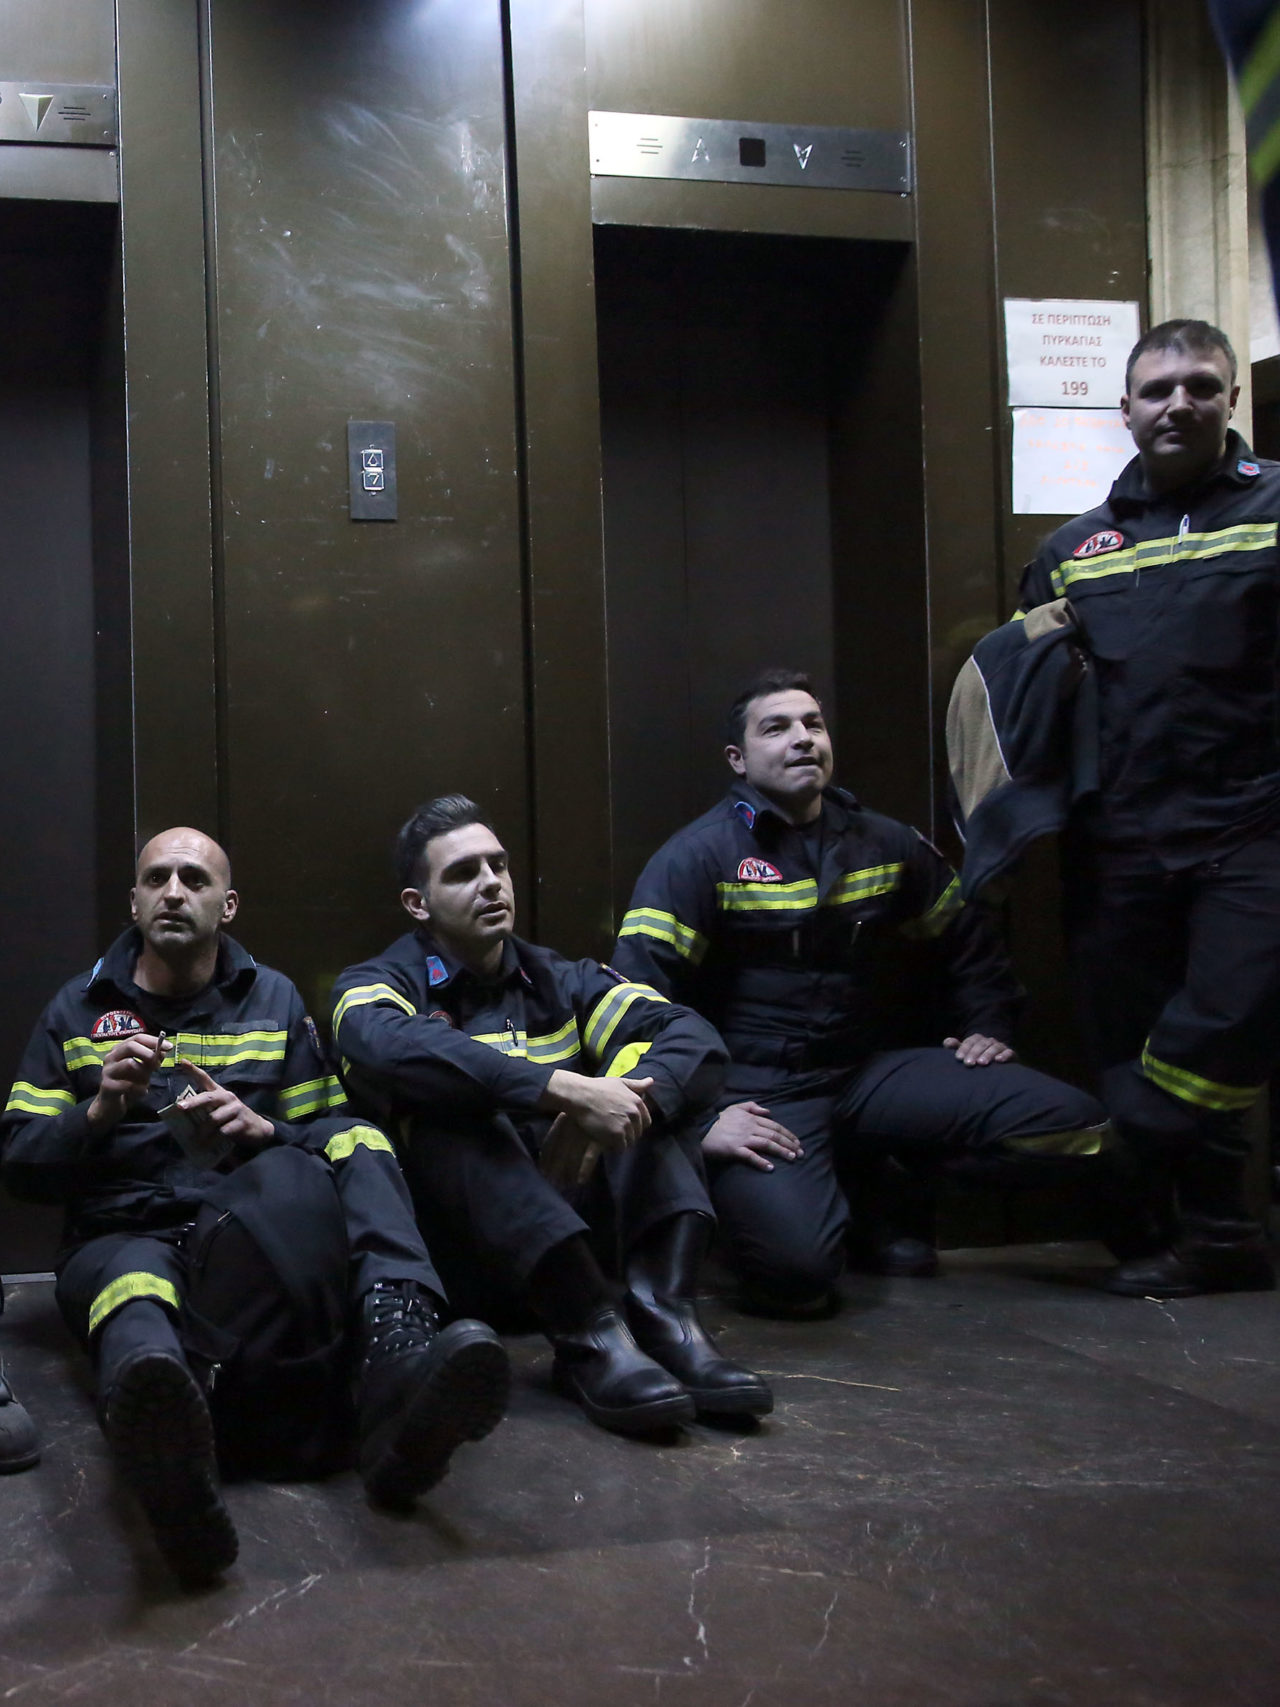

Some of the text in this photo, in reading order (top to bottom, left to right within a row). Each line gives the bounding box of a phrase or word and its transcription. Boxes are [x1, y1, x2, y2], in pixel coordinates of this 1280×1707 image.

[1032, 313, 1112, 327] ΣΕ ΠΕΡΙΠΤΩΣΗ
[1040, 355, 1107, 368] ΚΑΛΕΣΤΕ ΤΟ
[1061, 381, 1089, 396] 199
